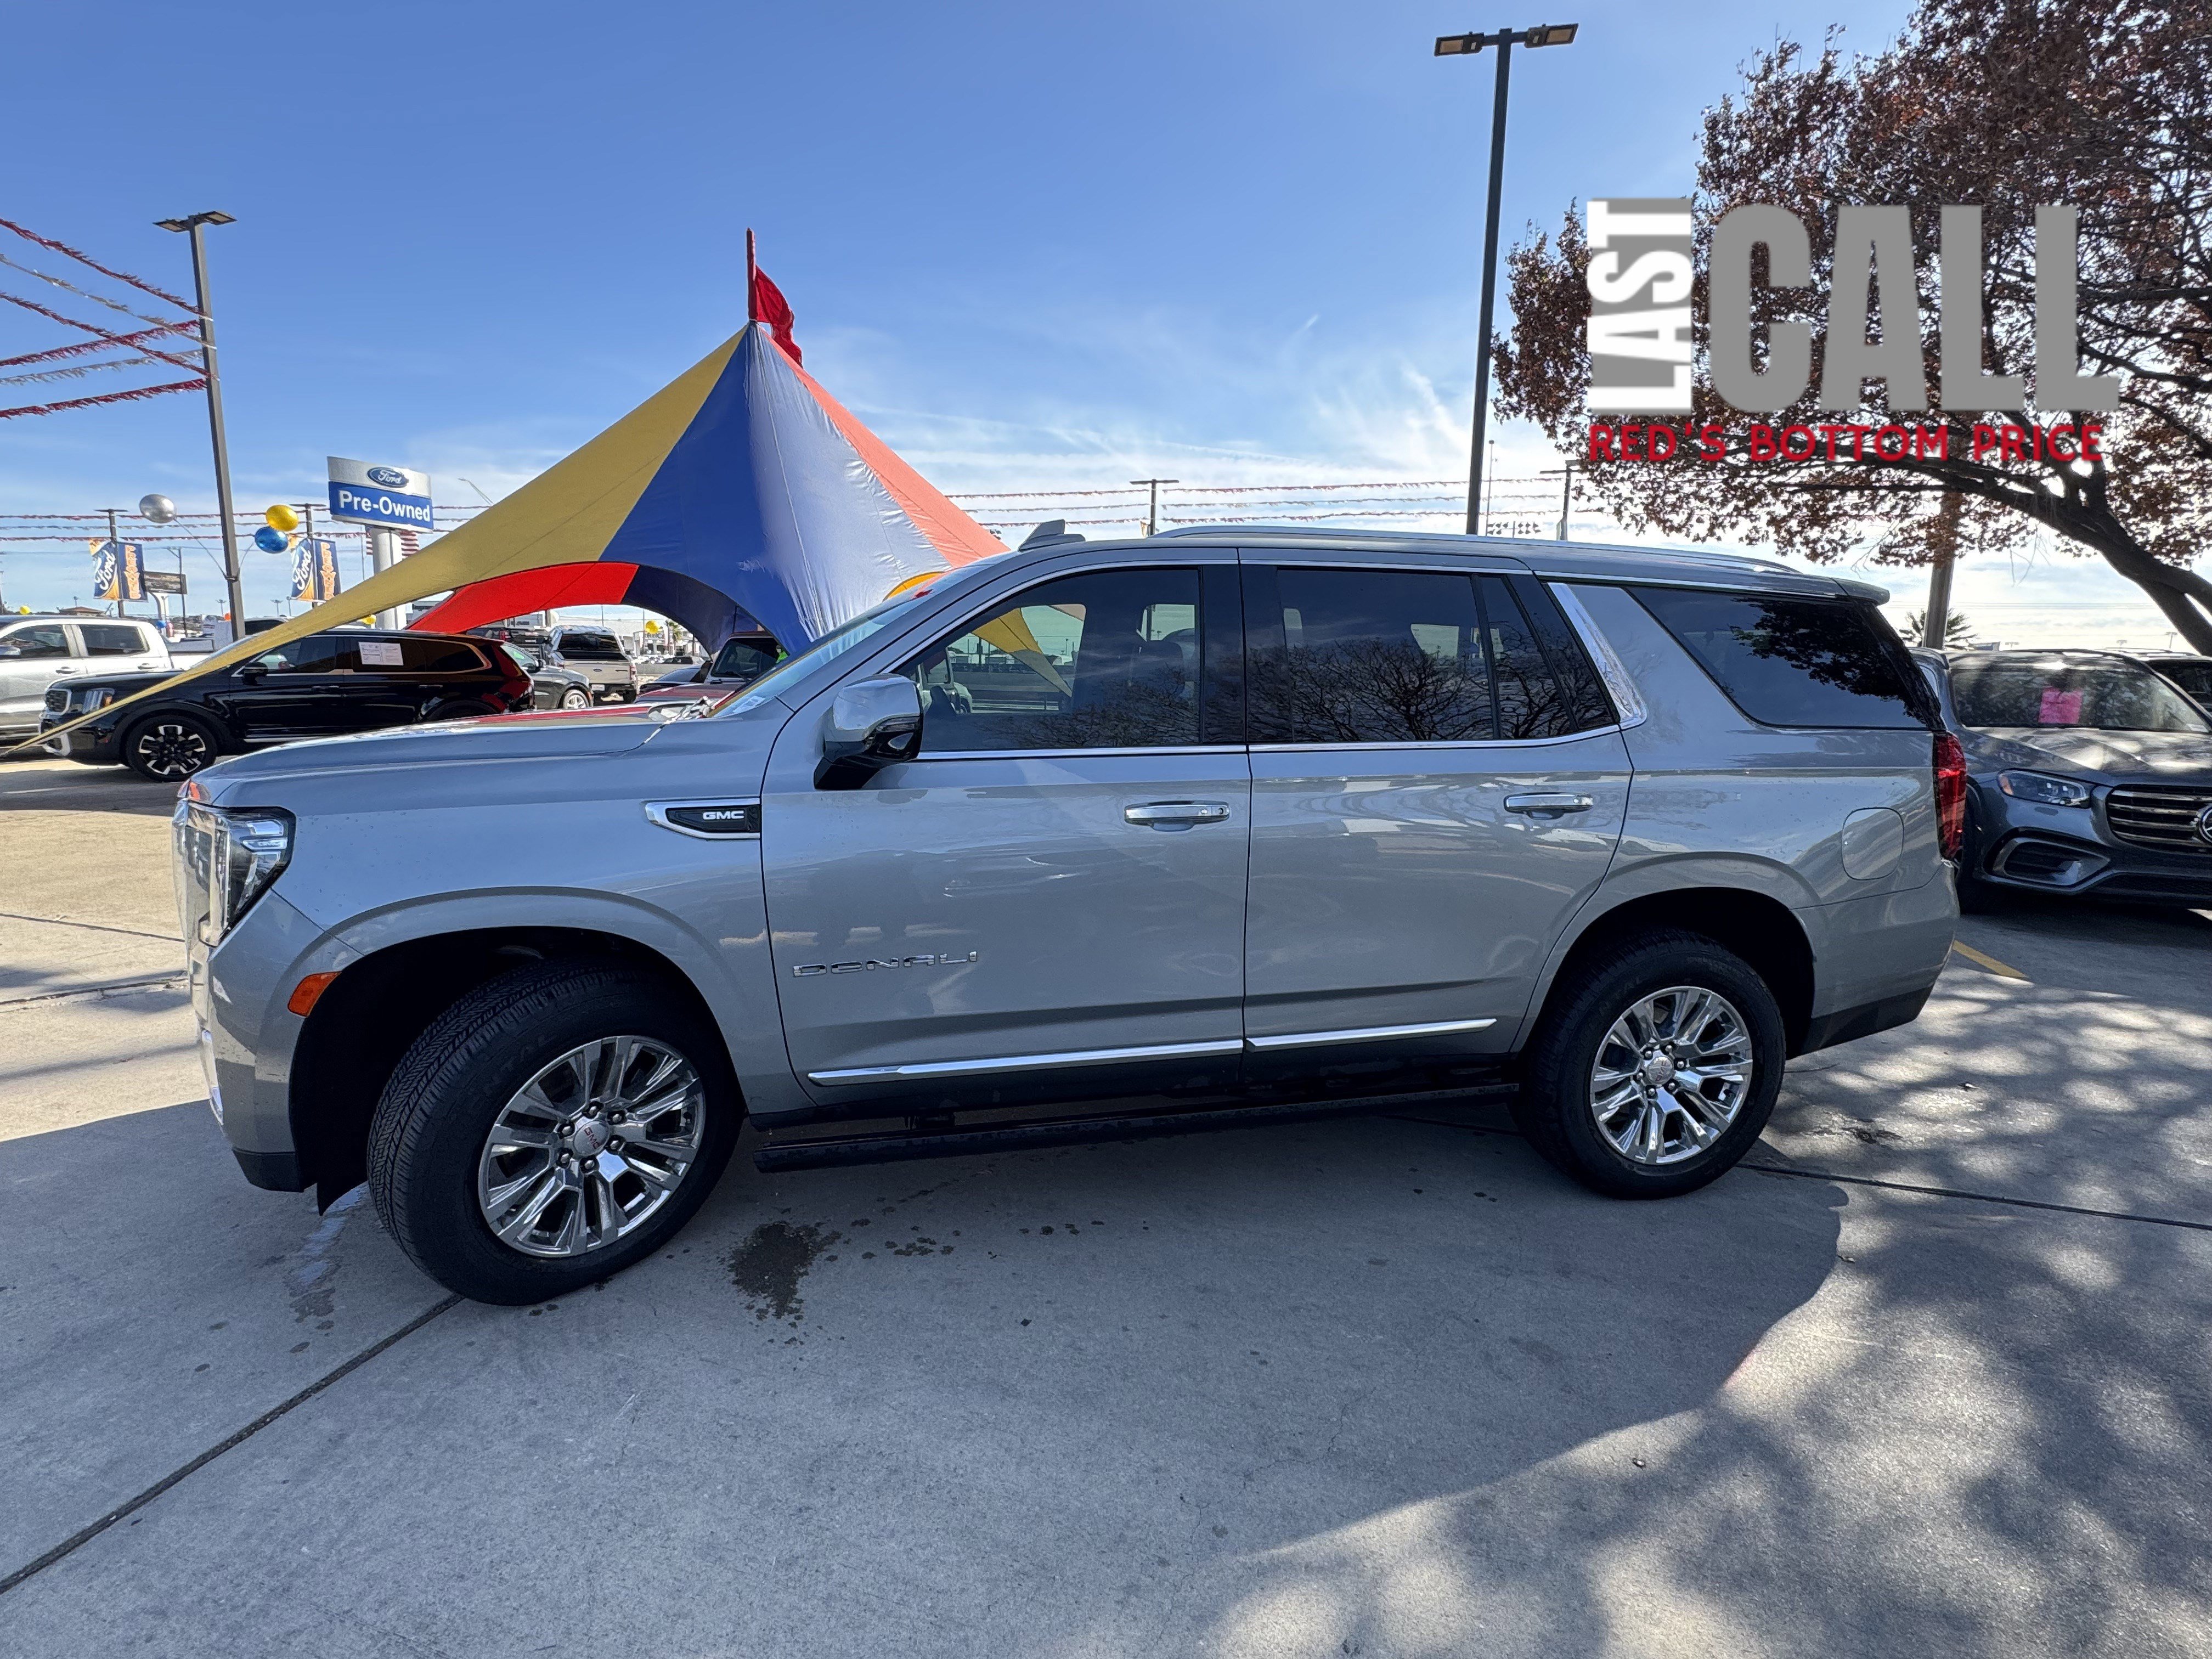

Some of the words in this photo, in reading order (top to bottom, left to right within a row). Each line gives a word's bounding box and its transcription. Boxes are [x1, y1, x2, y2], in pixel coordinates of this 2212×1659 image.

[377, 470, 403, 484] Ford
[338, 490, 431, 522] Pre-Owned
[93, 549, 116, 590] Ford
[291, 545, 312, 590] Ford
[703, 810, 744, 820] GMC
[793, 950, 978, 978] DENALI
[584, 1126, 601, 1150] GMC
